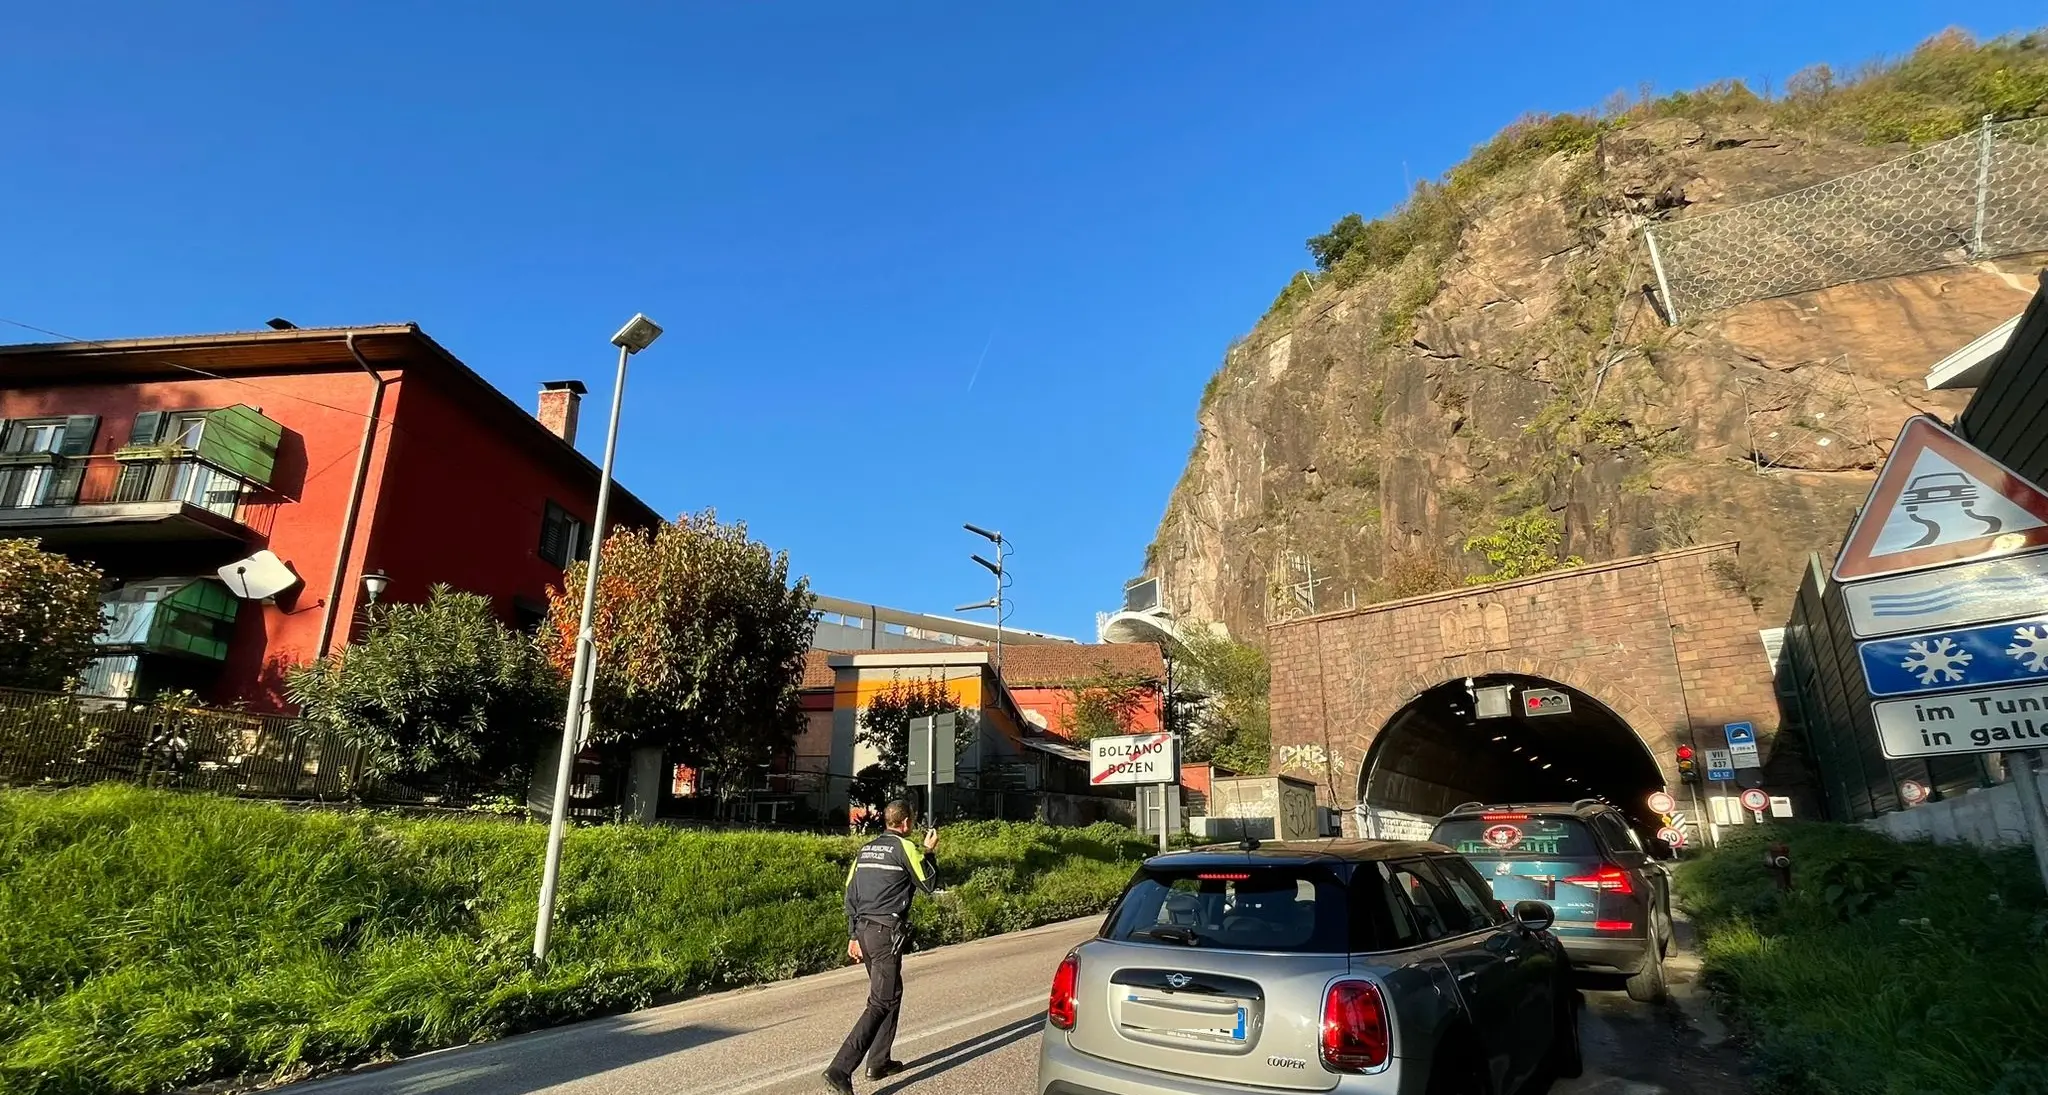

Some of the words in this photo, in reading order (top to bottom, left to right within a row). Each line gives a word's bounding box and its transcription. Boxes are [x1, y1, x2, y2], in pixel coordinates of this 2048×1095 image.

[1915, 704, 1955, 722] im
[1921, 728, 1952, 747] in
[1099, 742, 1163, 758] BOLZANO
[1108, 761, 1154, 774] BOZEN
[1663, 832, 1678, 843] 30
[1266, 1057, 1306, 1070] COOPER
